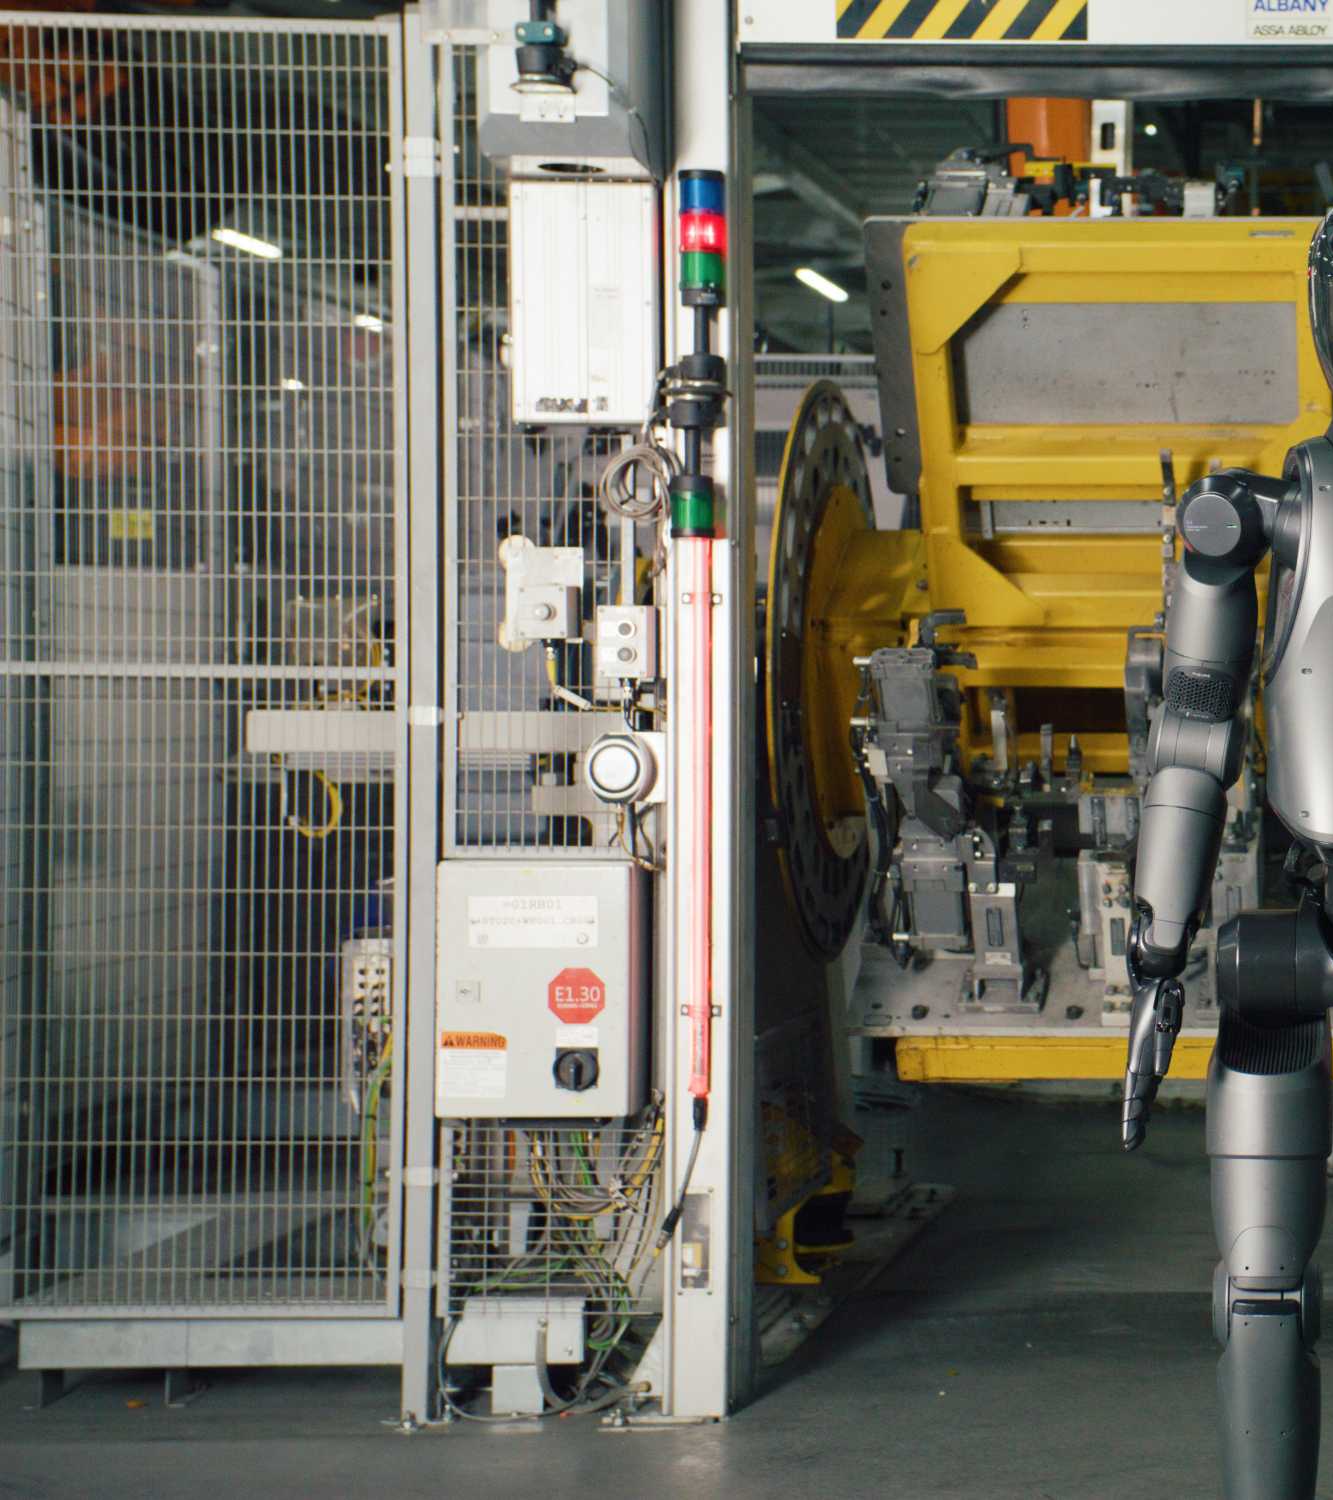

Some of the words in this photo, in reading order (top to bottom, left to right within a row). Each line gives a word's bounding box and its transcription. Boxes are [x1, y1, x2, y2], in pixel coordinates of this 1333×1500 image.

[1253, 0, 1329, 12] ALBANY
[1253, 25, 1285, 36] ASSA
[1288, 25, 1328, 36] ABLOY
[555, 986, 600, 1002] E1.30
[455, 1034, 505, 1048] WARNING
